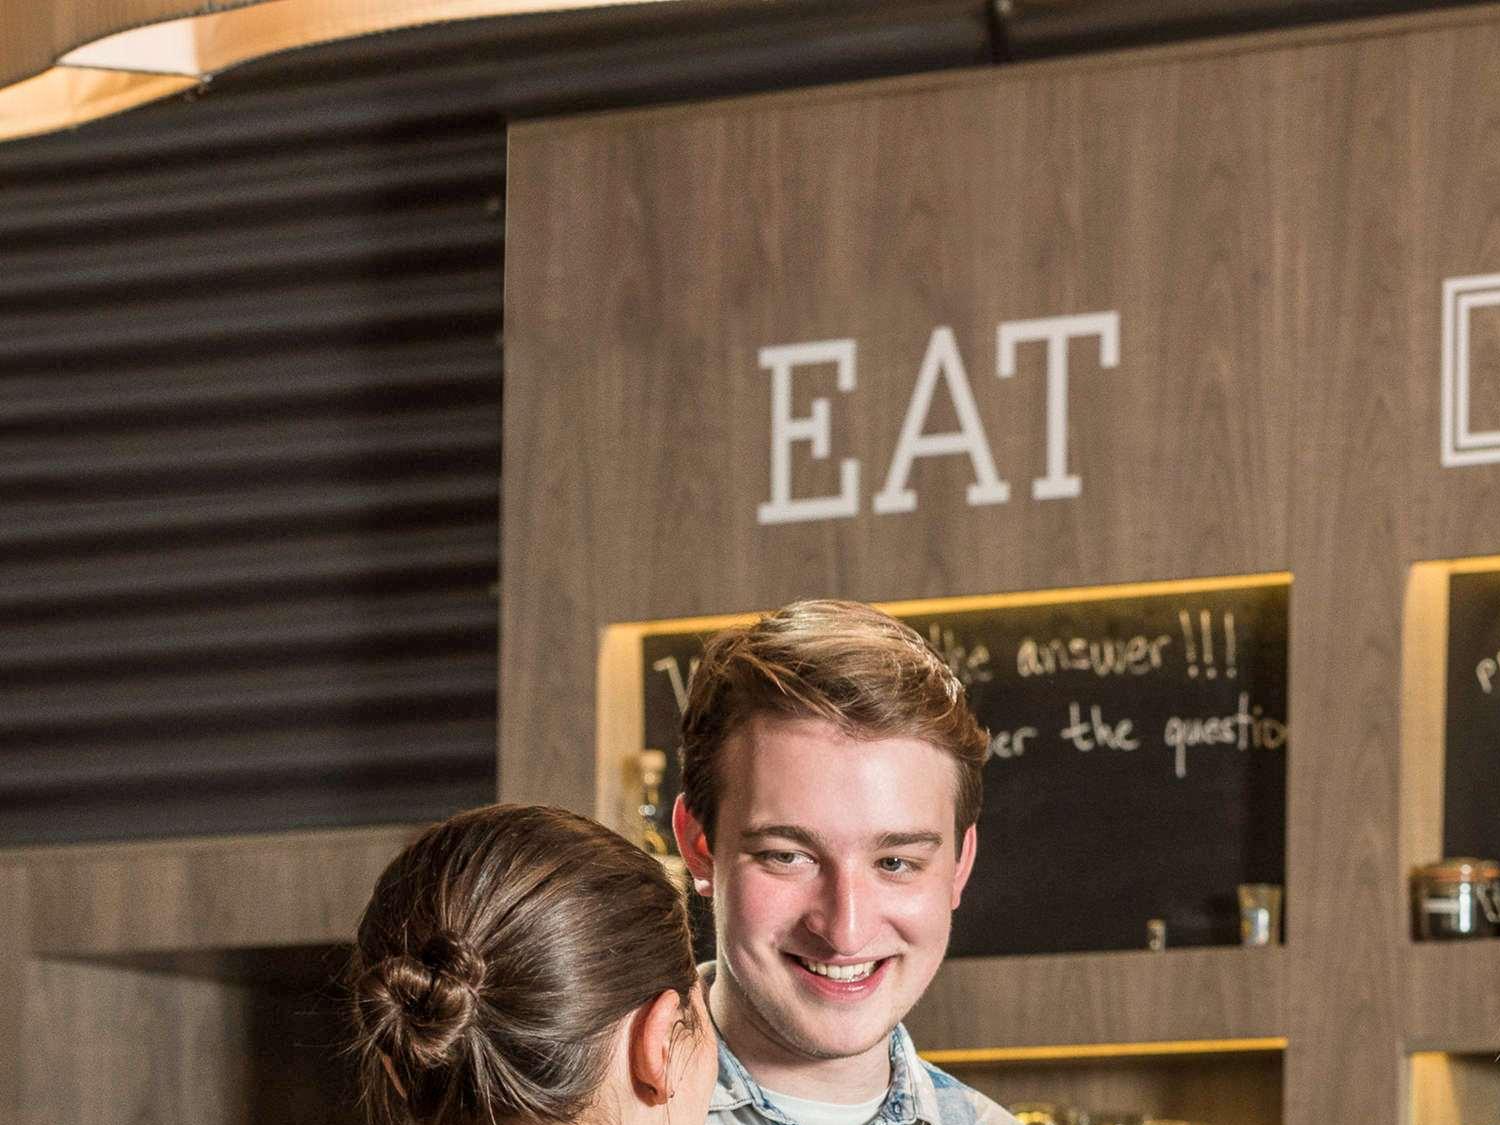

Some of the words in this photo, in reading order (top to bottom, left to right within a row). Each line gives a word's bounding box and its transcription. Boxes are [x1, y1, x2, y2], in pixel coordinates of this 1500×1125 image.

[757, 310, 1121, 526] EAT
[1059, 701, 1141, 752] the
[1163, 690, 1286, 779] questio
